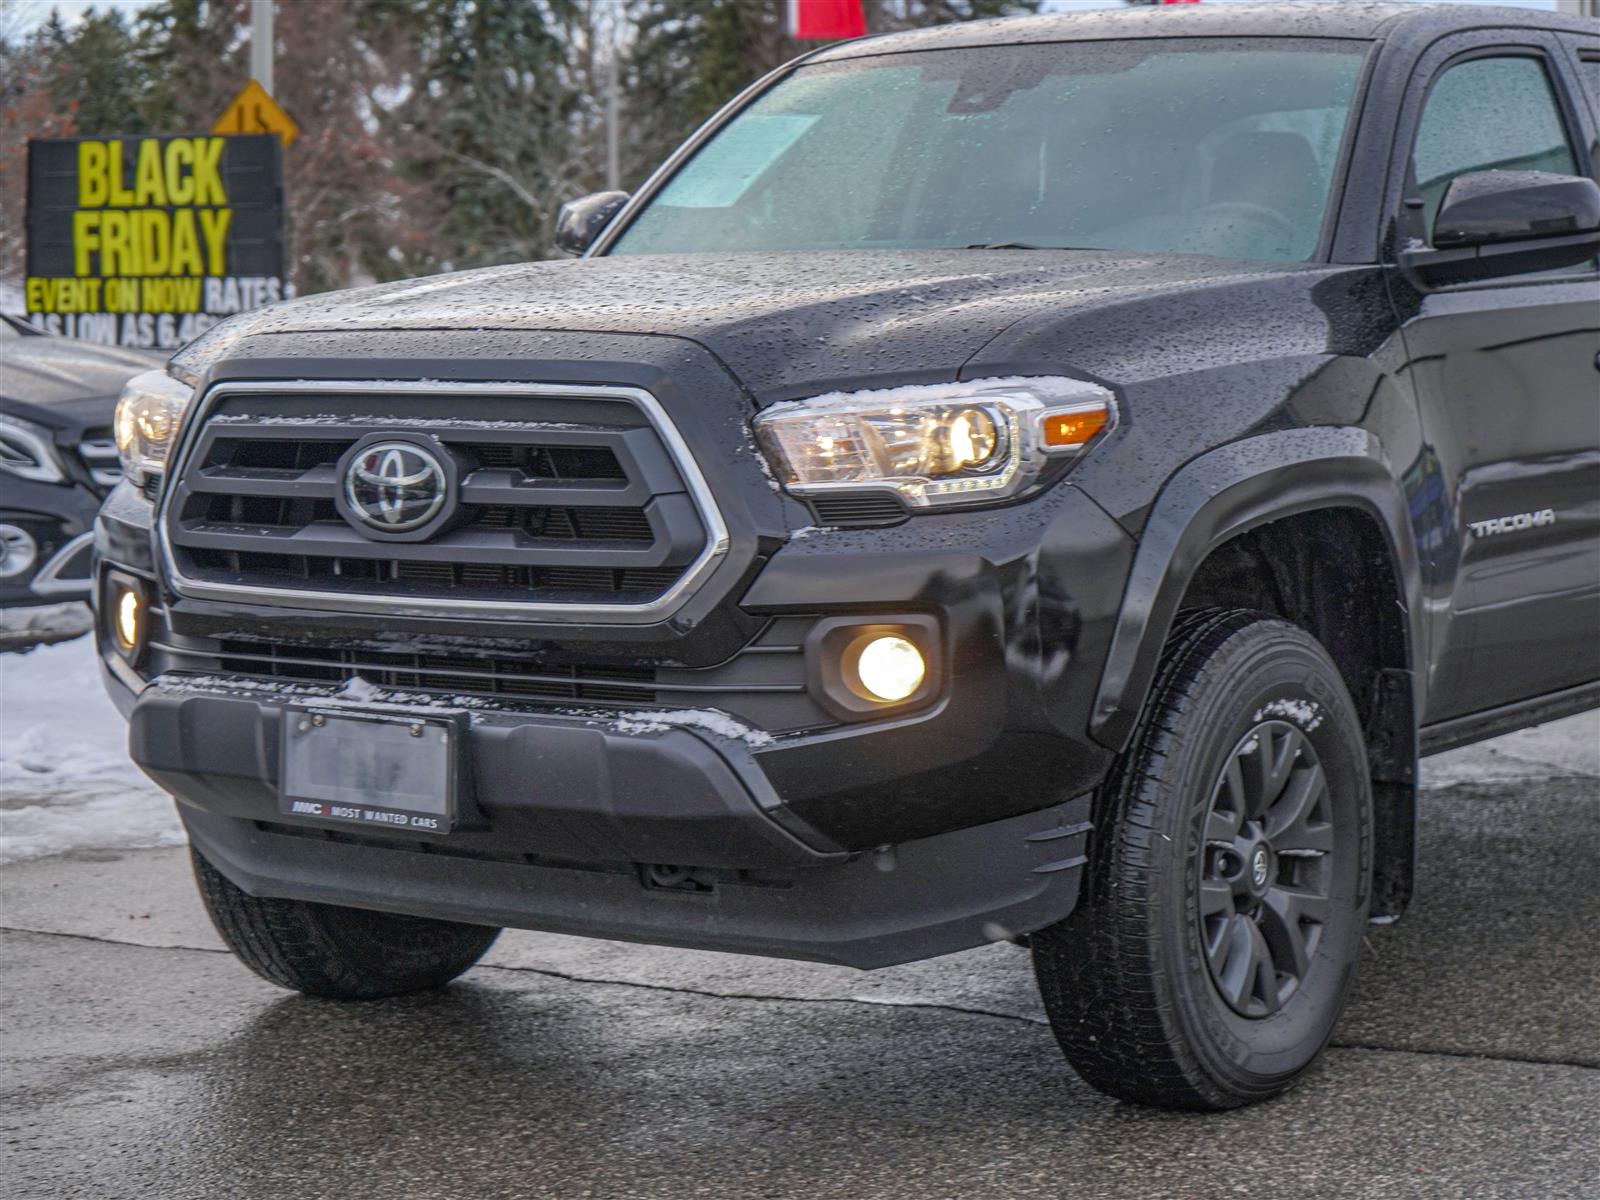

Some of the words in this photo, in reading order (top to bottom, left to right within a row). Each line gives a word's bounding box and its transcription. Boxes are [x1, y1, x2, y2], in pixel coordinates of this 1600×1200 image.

[78, 137, 228, 208] BLACK
[73, 208, 233, 277] FRIDAY
[26, 277, 101, 313] EVENT
[104, 277, 140, 313] ON
[142, 277, 202, 313] NOW
[205, 276, 281, 314] RATES
[120, 313, 155, 348] AS
[1466, 508, 1556, 538] TACOMA
[331, 806, 361, 819] MOST
[364, 810, 408, 825] WANTED
[411, 816, 438, 829] CARS
